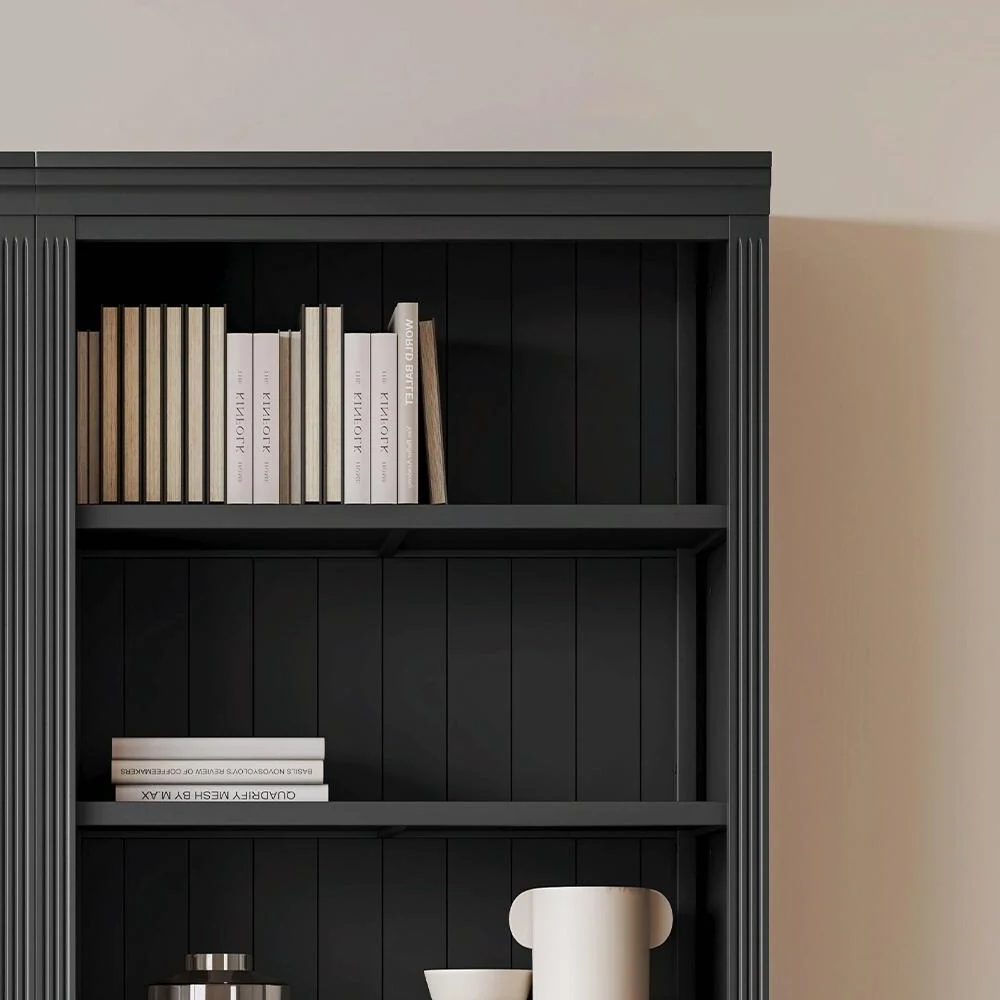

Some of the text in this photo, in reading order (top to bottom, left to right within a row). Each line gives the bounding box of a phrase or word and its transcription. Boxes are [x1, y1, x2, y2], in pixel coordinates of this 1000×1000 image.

[141, 790, 296, 800] QUADRIFY MESH BY M.AX
